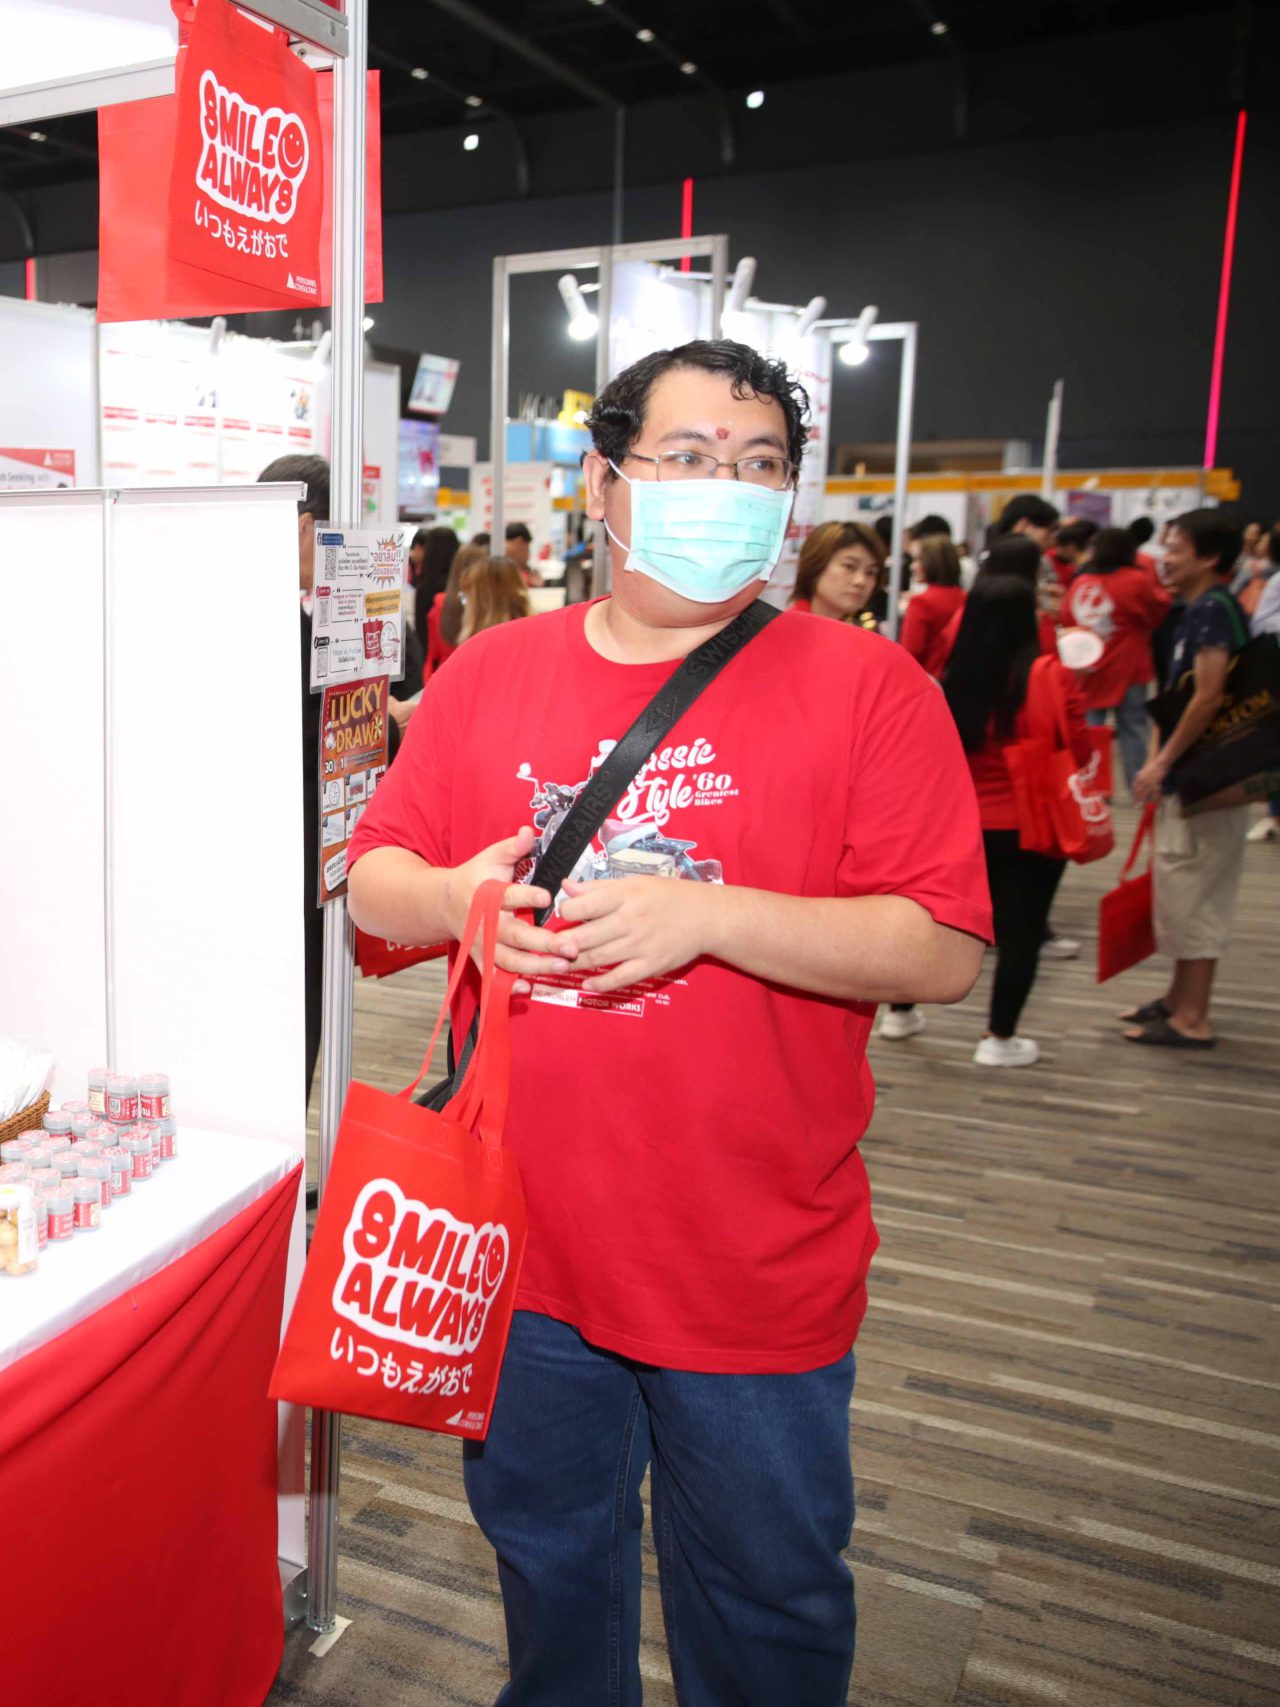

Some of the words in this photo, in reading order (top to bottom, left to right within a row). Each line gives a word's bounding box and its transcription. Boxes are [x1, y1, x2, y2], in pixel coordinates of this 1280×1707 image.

[200, 142, 294, 215] ALWAYS
[194, 200, 288, 258] いつもえがおで
[331, 679, 385, 729] LUCKY
[336, 721, 379, 753] DRAW
[611, 1000, 642, 1013] WORKS
[340, 1262, 487, 1346] ALWAYS
[330, 1326, 473, 1396] いつもえがおで
